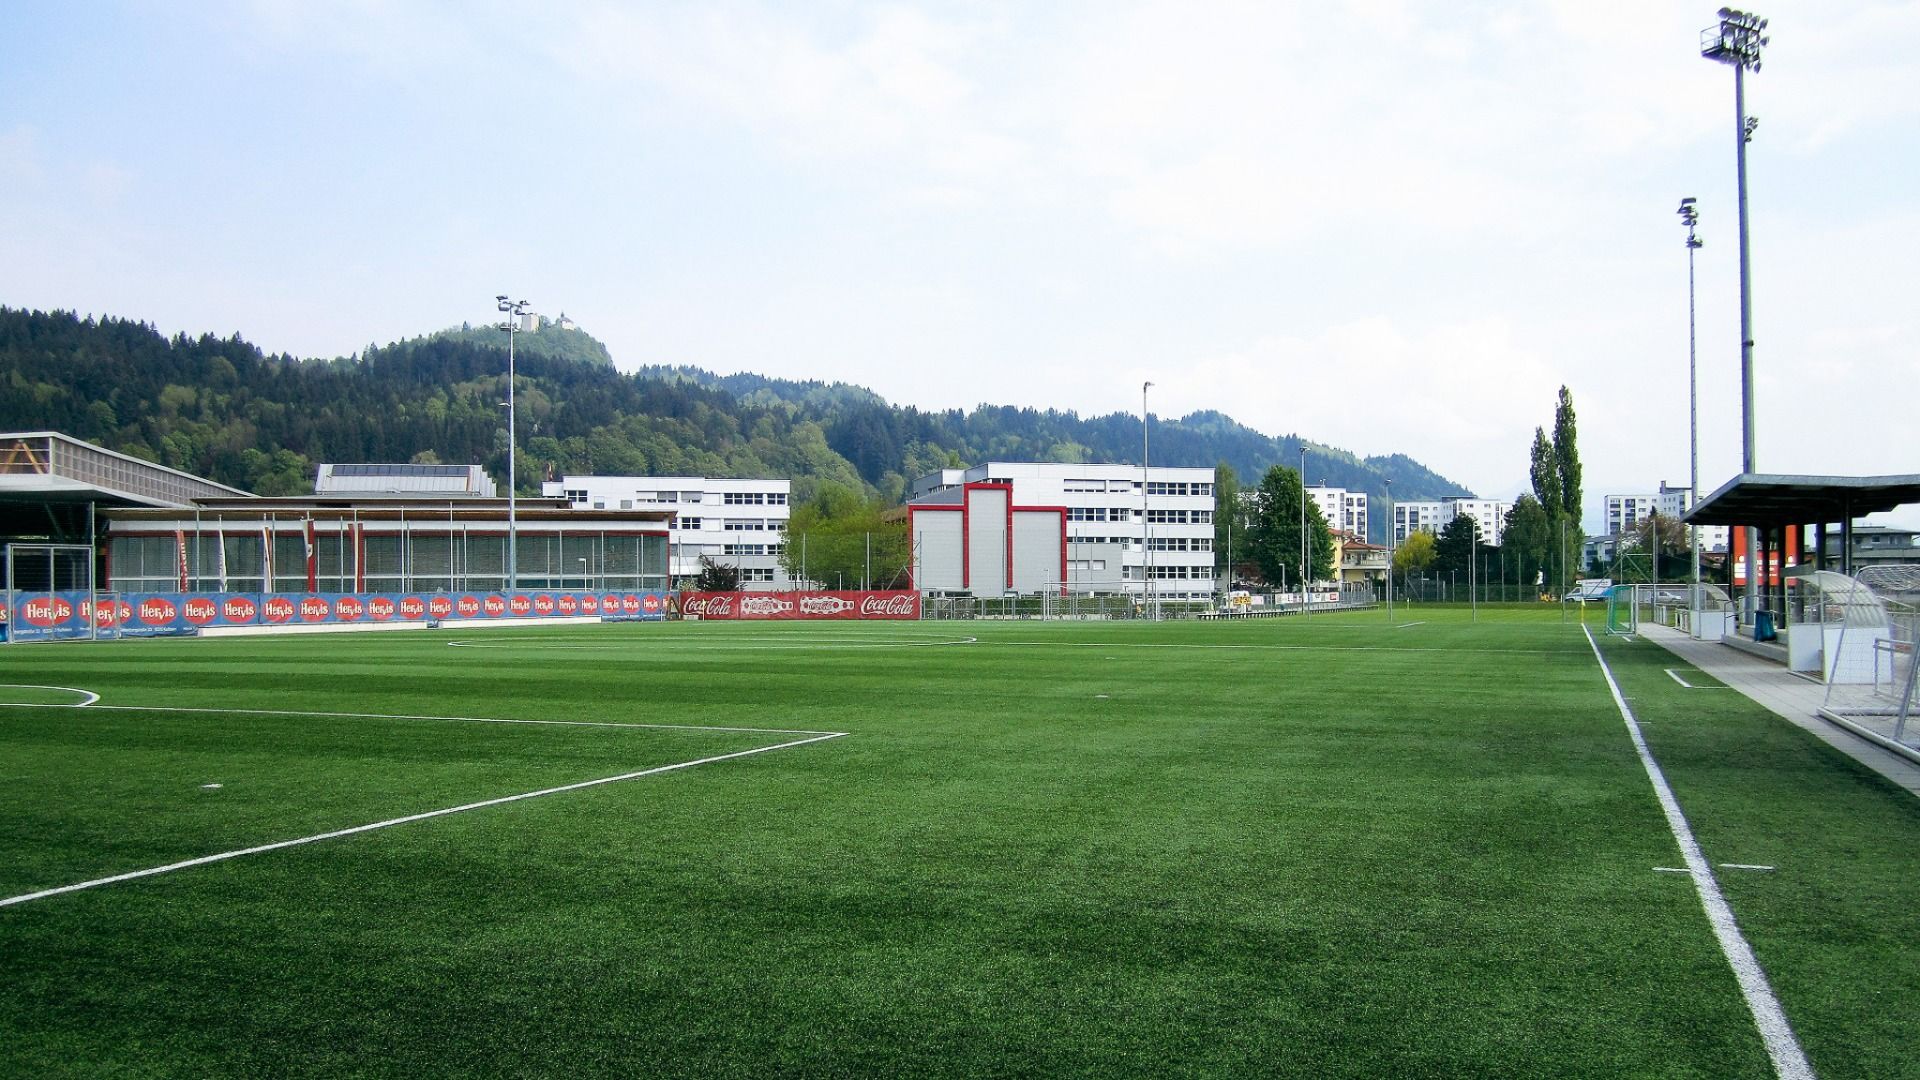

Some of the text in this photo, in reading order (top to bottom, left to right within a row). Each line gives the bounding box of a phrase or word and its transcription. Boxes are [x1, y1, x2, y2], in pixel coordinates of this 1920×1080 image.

[141, 604, 175, 620] Hervis
[185, 603, 215, 619] Hervis
[224, 602, 254, 618] Hervis
[265, 602, 293, 617] Hervis
[301, 602, 329, 617] Hervis
[336, 602, 362, 616] Hervis
[369, 602, 393, 615] Hervis
[401, 601, 423, 614] Hervis
[429, 601, 451, 614] Hervis
[458, 601, 478, 613] Hervis
[484, 600, 504, 613] Hervis
[511, 600, 530, 612] Hervis
[860, 595, 917, 615] Coca-Cola
